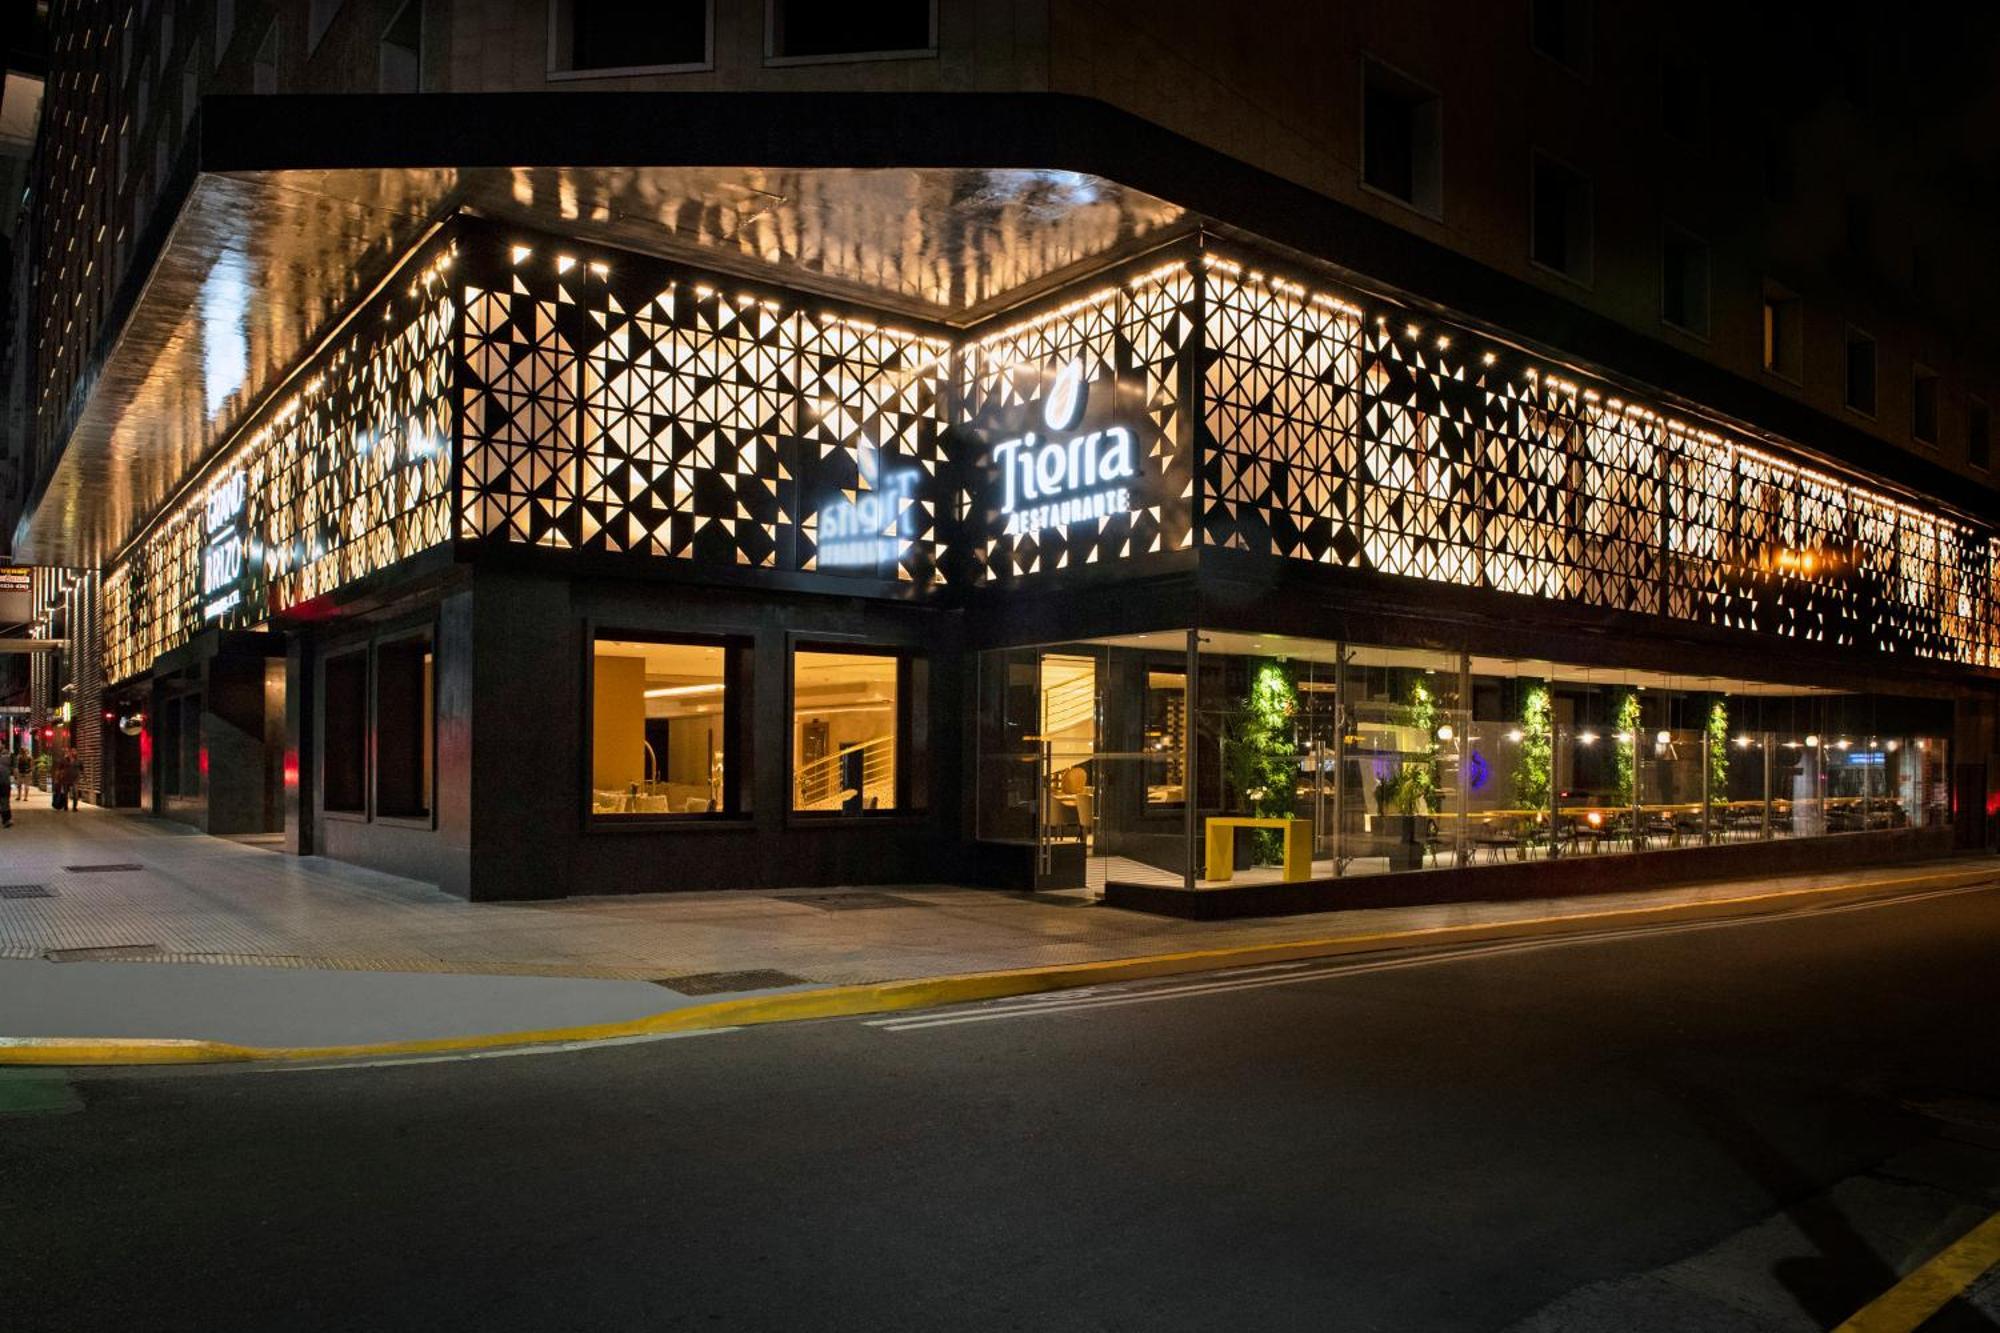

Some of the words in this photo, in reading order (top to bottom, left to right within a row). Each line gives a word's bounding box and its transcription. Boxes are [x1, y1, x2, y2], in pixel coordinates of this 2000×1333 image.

[993, 426, 1134, 514] Tierra
[1008, 487, 1129, 534] RESTAURANTE
[205, 535, 241, 594] BRIZO
